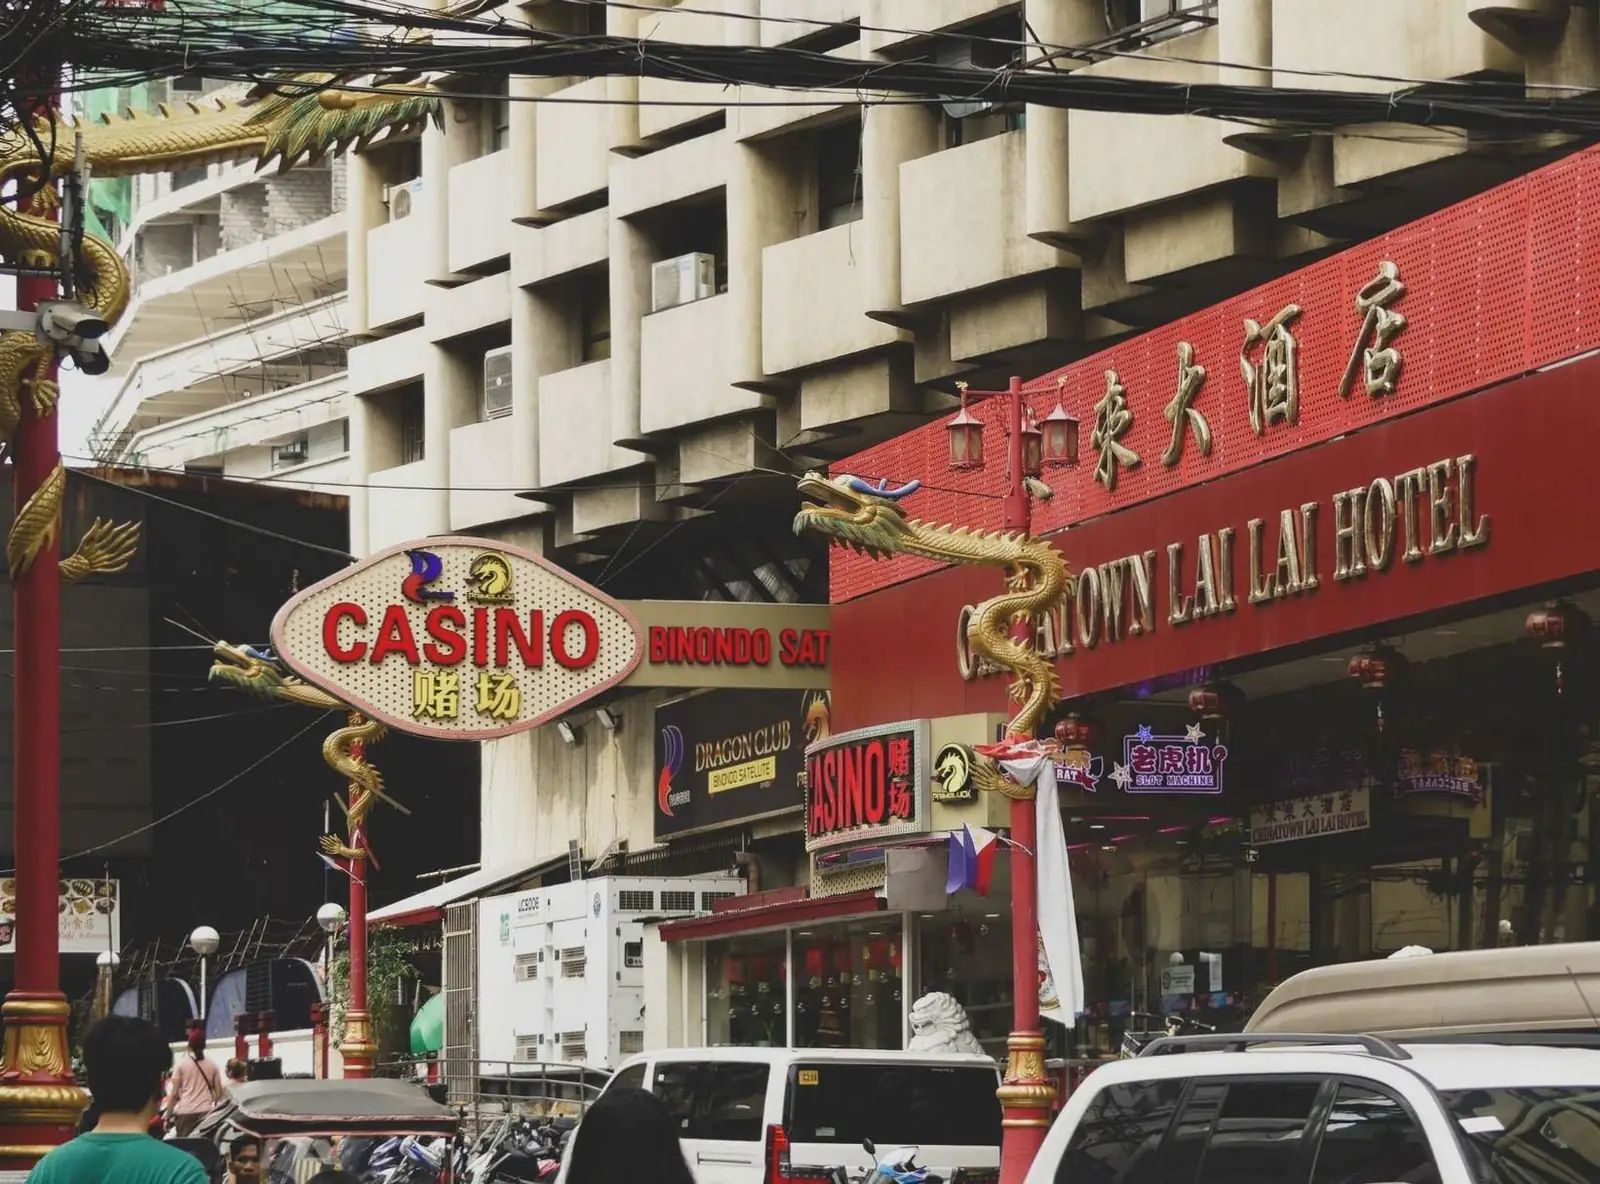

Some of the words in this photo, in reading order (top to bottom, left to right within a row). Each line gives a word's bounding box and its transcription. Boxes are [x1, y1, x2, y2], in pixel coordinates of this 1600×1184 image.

[957, 551, 1156, 680] CATOWN
[1167, 527, 1236, 625] LAI
[1248, 501, 1319, 604] LAI
[1333, 453, 1490, 581] HOTEL
[322, 602, 600, 669] CASINO
[649, 626, 771, 664] BINONDO
[412, 670, 521, 719] 赌场
[695, 732, 752, 773] DRAGON
[754, 720, 792, 755] CLUB
[1131, 745, 1213, 774] 老虎机
[738, 761, 771, 782] SATELLITE
[1136, 775, 1164, 787] SLOT
[1166, 775, 1214, 787] MACHINE
[1305, 817, 1320, 835] LAI
[1321, 815, 1337, 833] LAI
